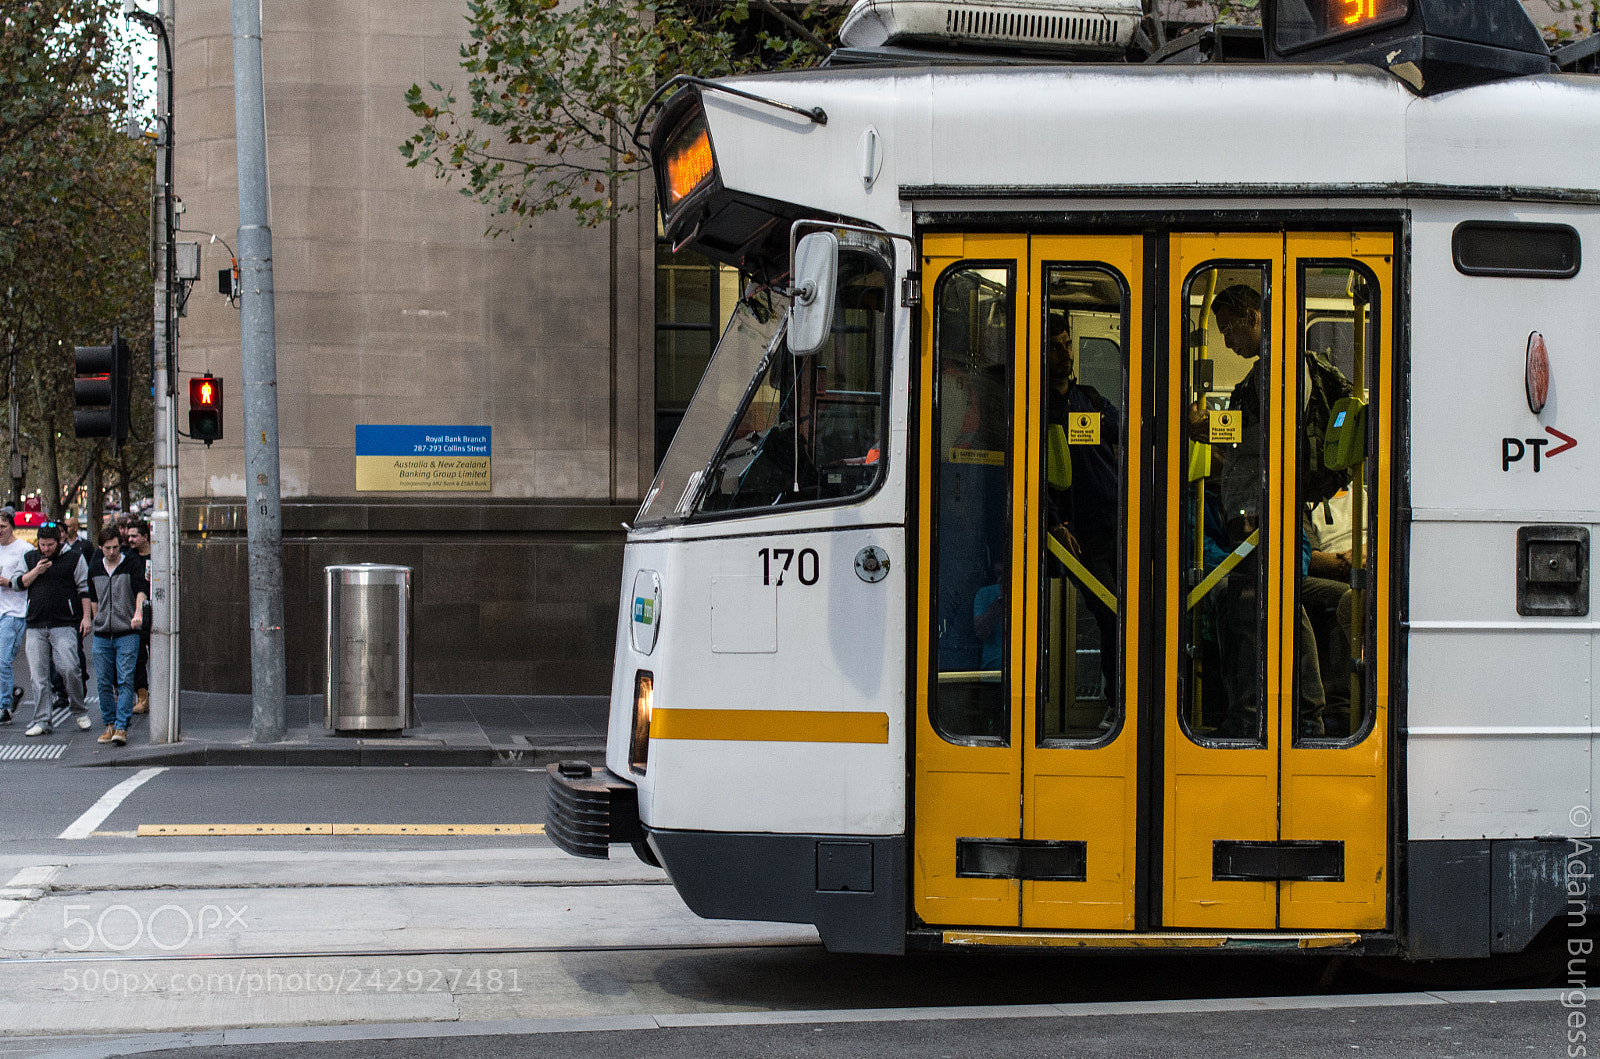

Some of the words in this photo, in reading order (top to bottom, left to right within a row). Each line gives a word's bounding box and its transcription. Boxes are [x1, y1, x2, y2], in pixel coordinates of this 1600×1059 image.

[426, 435, 443, 444] Royal
[444, 435, 461, 443] Bank
[413, 444, 442, 452] 287-293
[393, 460, 428, 468] Australia
[430, 460, 436, 468] &
[399, 470, 431, 479] Banking
[433, 470, 456, 479] Group
[458, 470, 487, 478] Limited
[758, 547, 820, 586] 170
